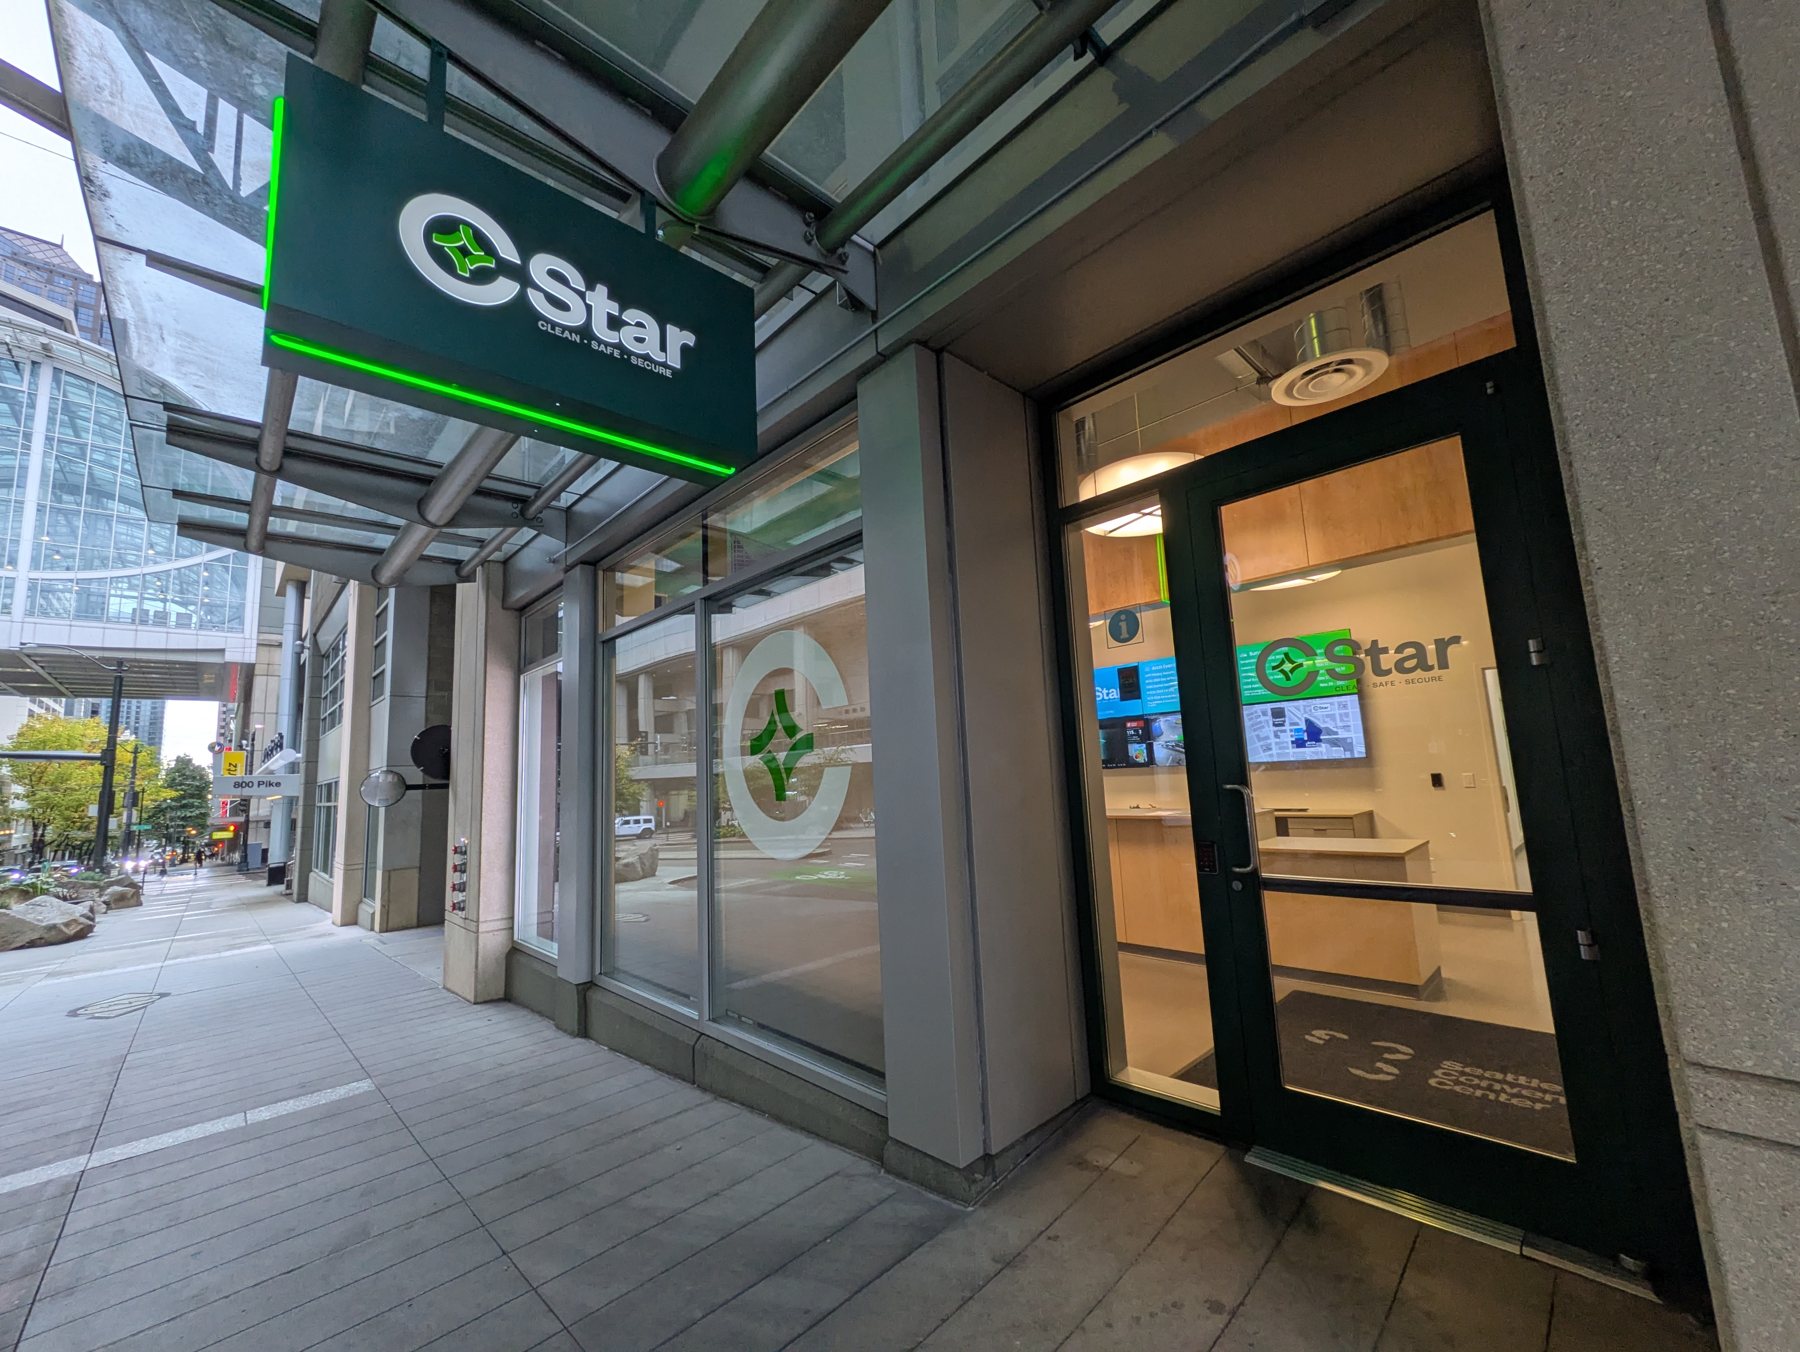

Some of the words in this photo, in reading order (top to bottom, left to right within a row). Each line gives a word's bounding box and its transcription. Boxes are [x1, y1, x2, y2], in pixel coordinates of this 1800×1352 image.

[537, 320, 581, 344] CLEAN
[590, 339, 621, 359] SAFE
[630, 354, 673, 378] SECURE
[1335, 683, 1361, 693] CLEA
[1372, 680, 1396, 689] SAFE
[1405, 675, 1444, 686] SECURE
[233, 780, 254, 789] 800
[257, 780, 282, 788] Pike
[1439, 1060, 1564, 1092] Seattle
[1427, 1077, 1552, 1110] Center
